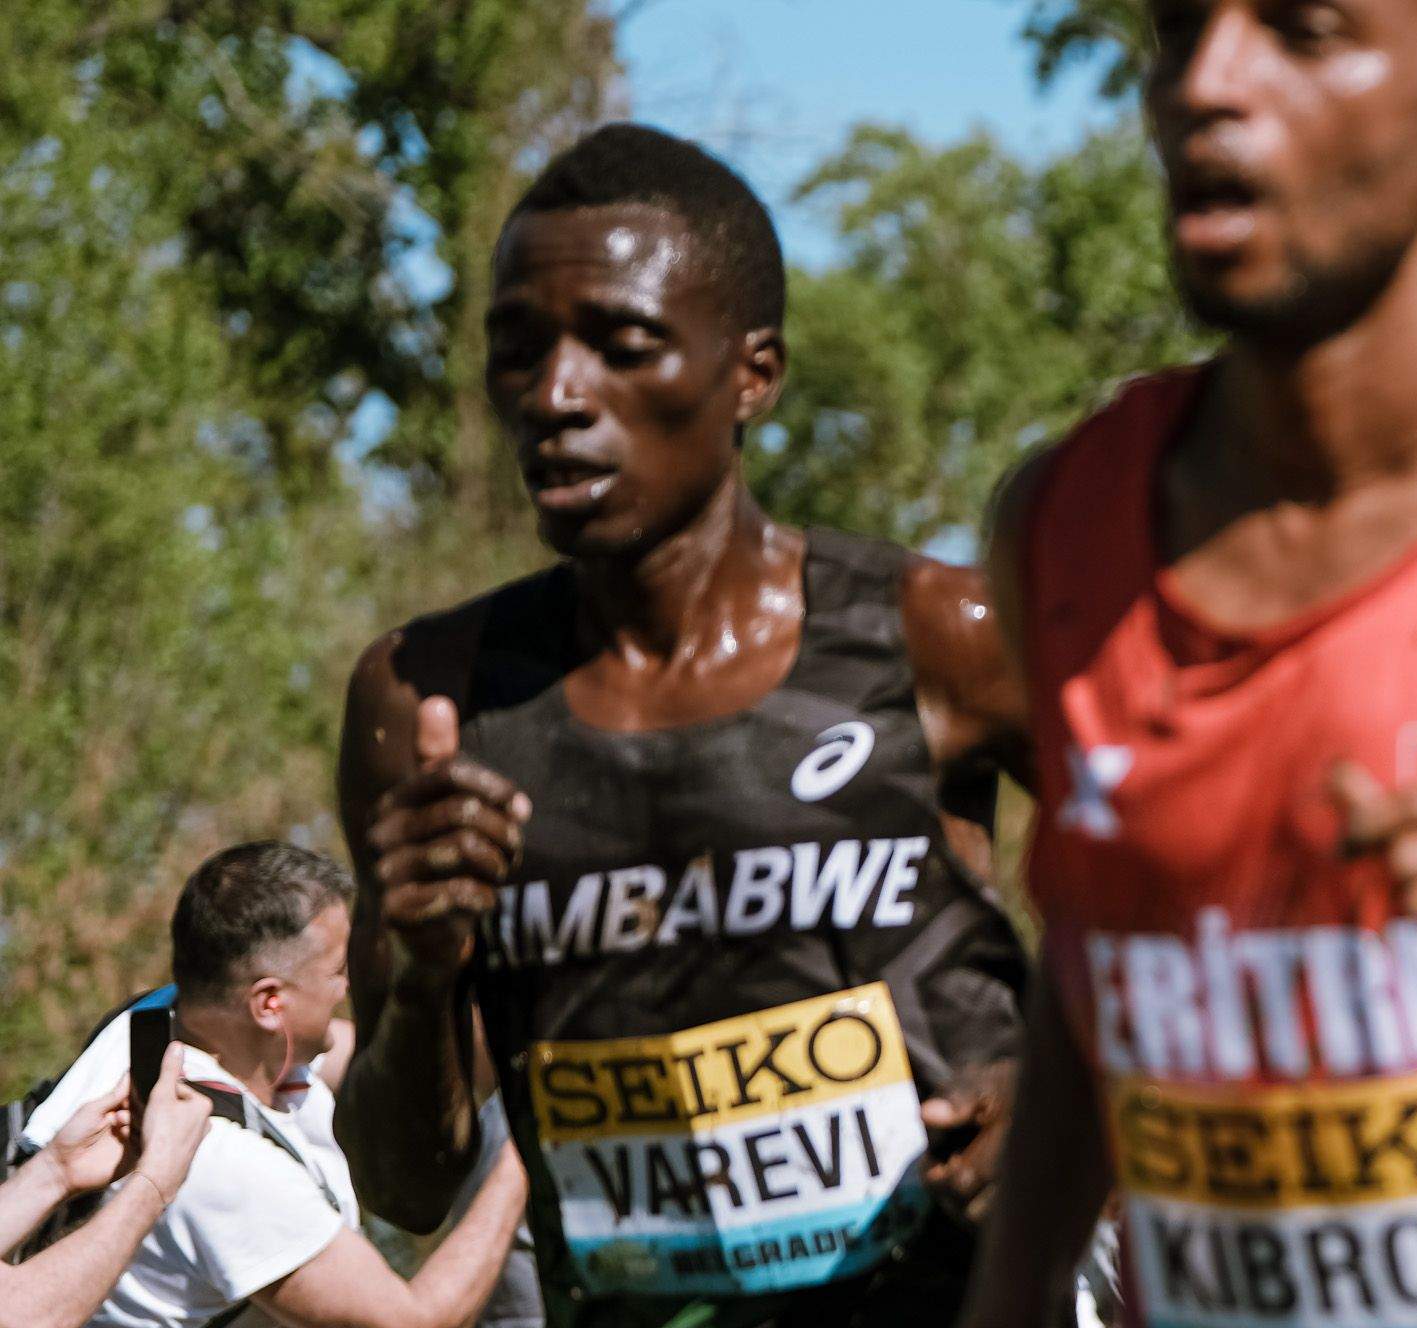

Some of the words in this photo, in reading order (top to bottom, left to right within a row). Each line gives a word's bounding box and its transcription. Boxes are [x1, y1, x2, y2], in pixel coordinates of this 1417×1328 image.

[482, 836, 930, 968] IMBABWE
[539, 1013, 882, 1131] SEIKO
[582, 1105, 881, 1221] VAREVI
